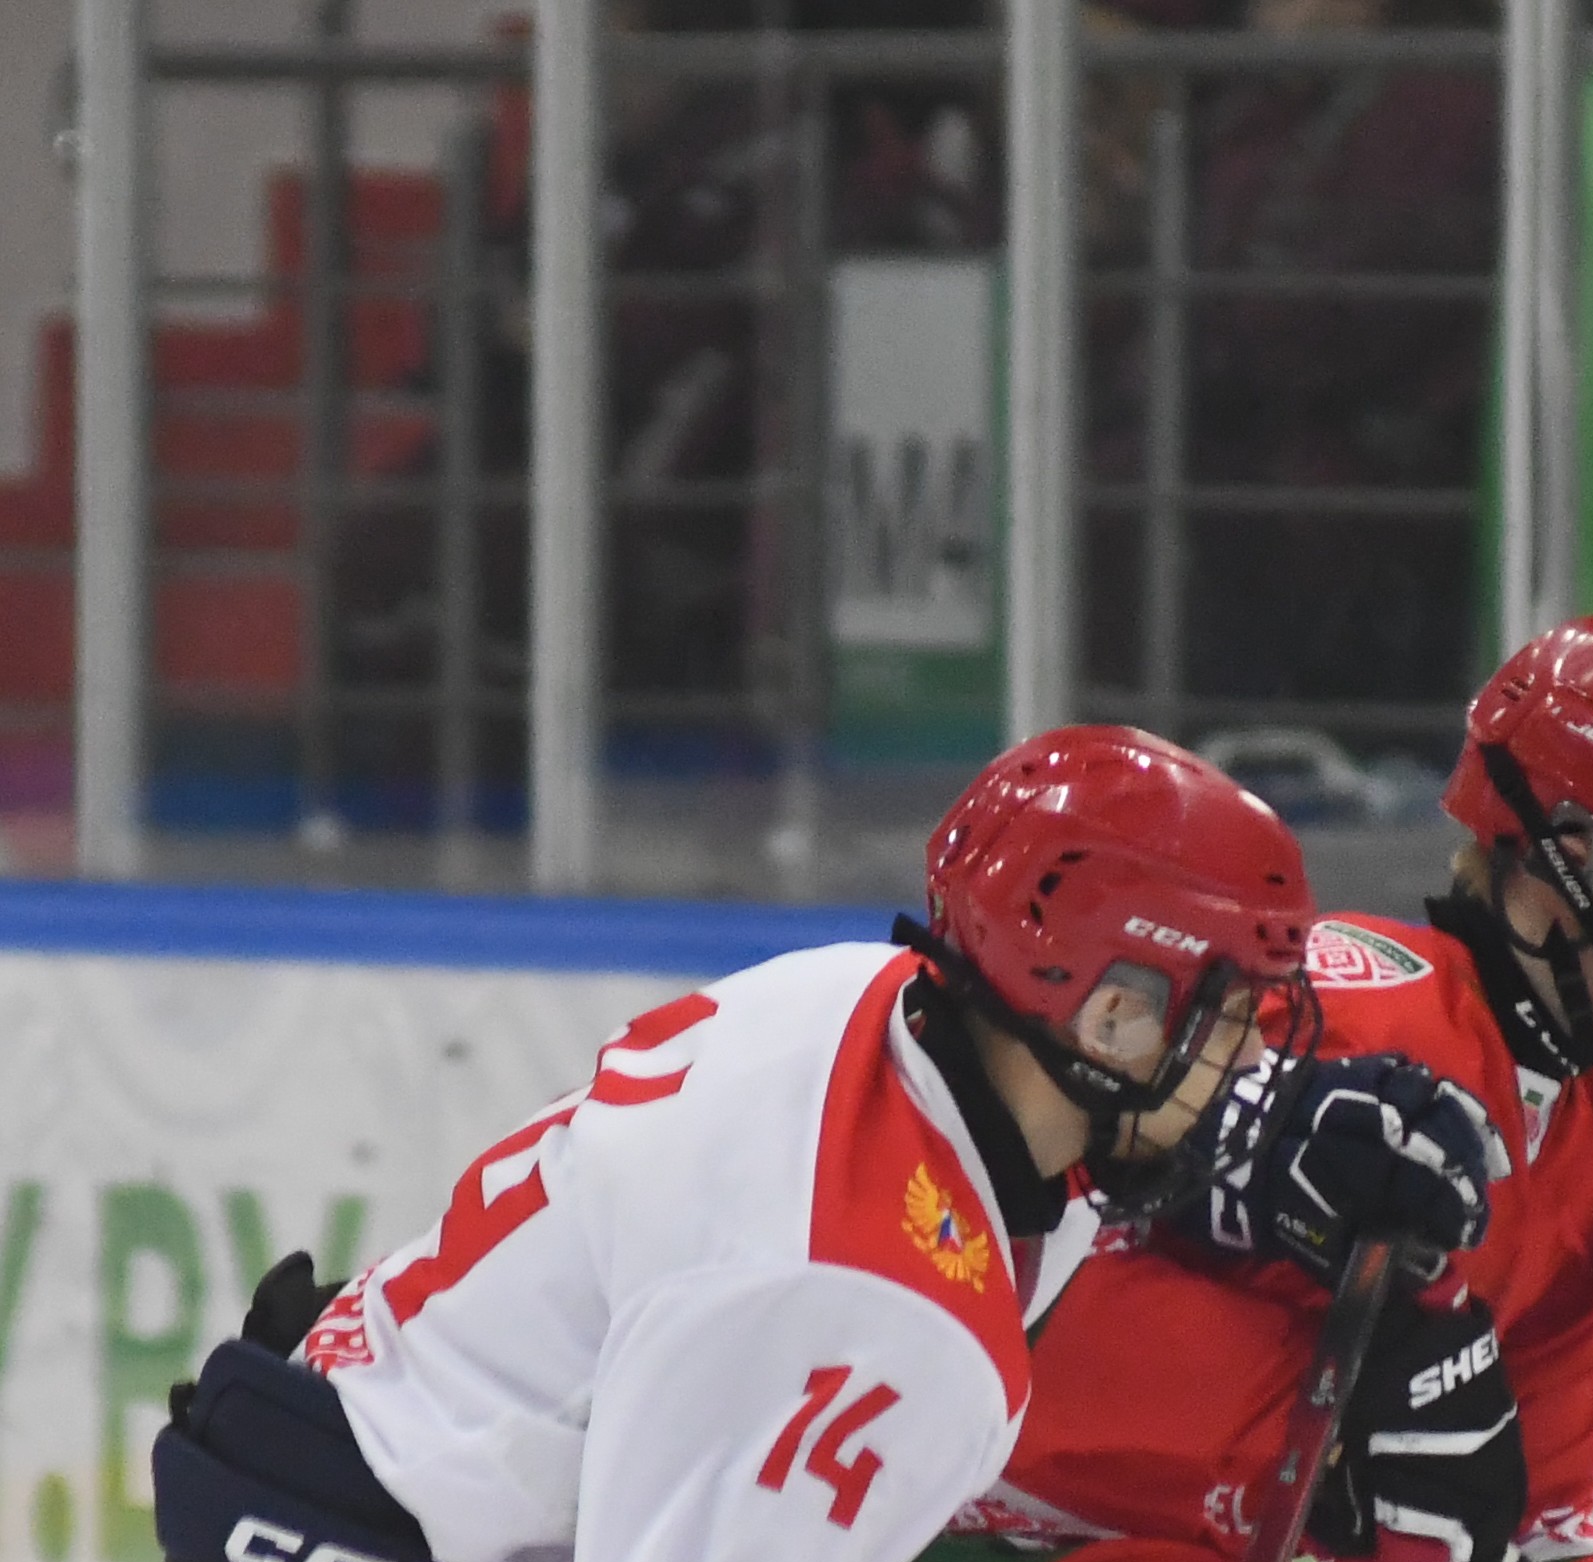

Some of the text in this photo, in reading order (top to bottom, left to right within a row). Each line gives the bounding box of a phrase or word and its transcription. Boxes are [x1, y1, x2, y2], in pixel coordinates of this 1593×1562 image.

[1541, 838, 1591, 908] BAUER
[1123, 915, 1210, 957] CCM
[1408, 1327, 1499, 1411] SHE
[756, 1364, 902, 1531] 14
